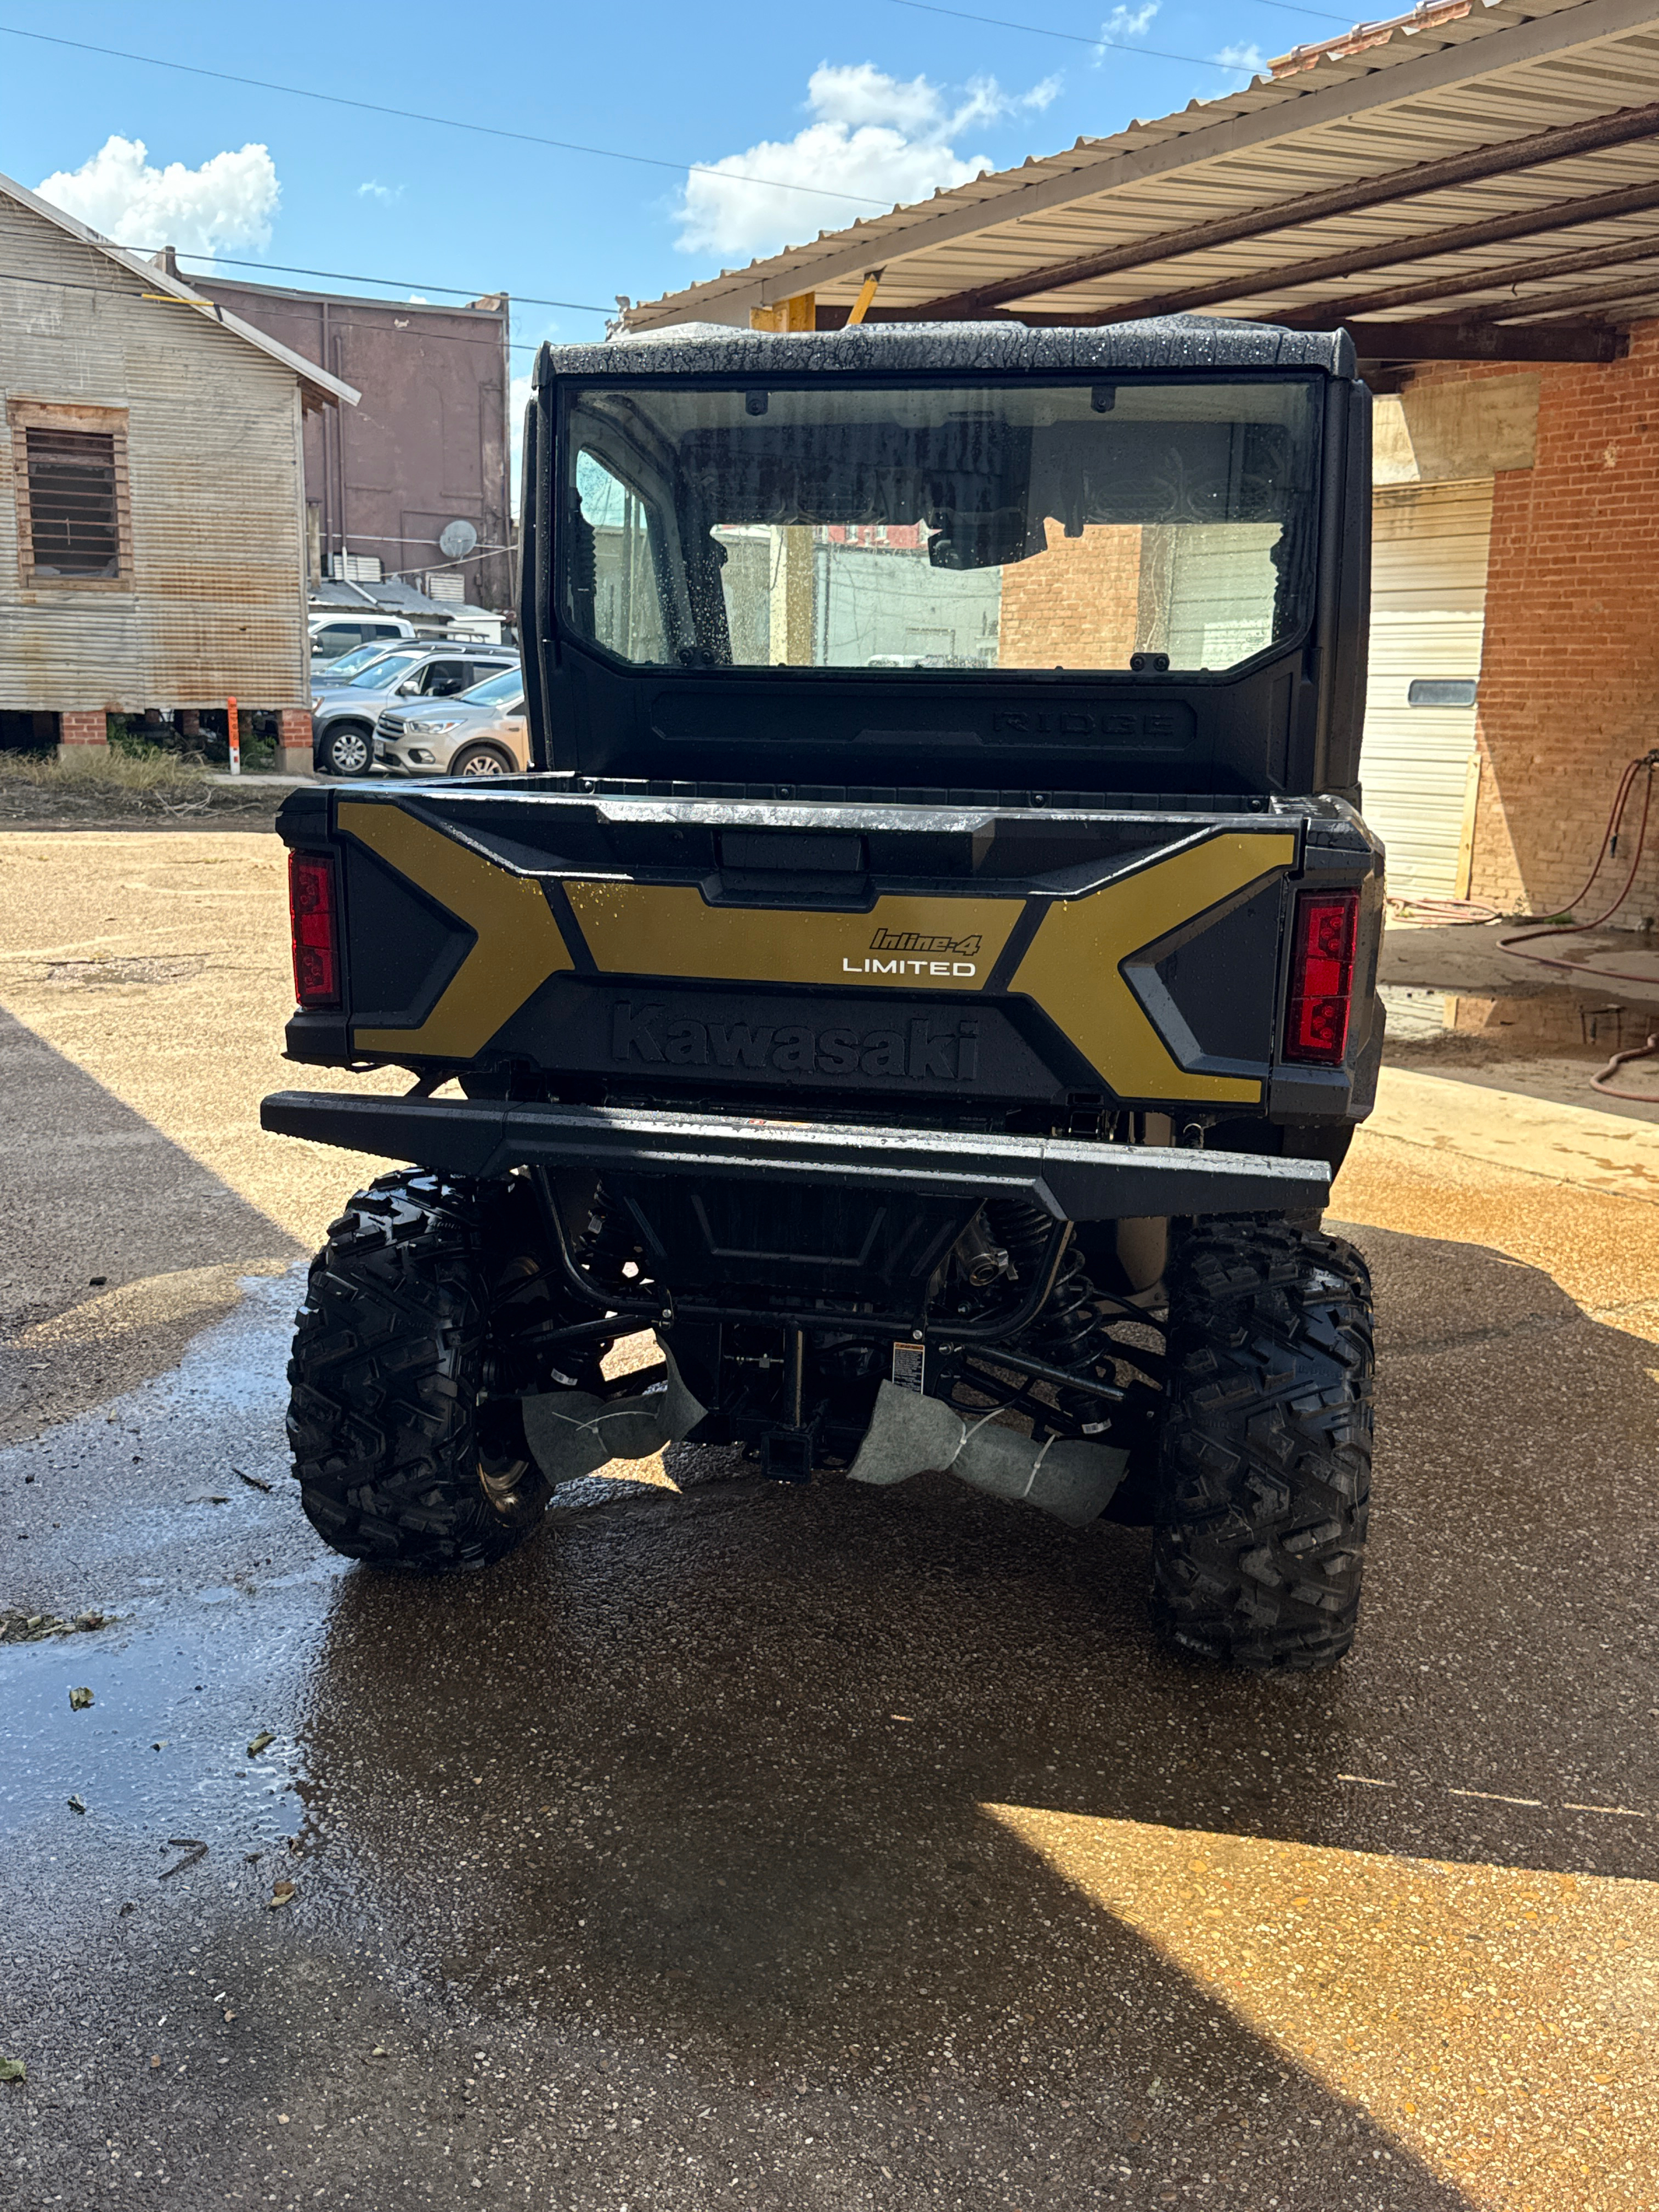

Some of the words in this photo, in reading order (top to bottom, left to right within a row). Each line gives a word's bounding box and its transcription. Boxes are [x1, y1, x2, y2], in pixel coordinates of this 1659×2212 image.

[993, 712, 1175, 736] RIDGE
[870, 928, 982, 956] Inline-4
[843, 958, 976, 977] LIMITED
[613, 1001, 978, 1080] Kawasaki
